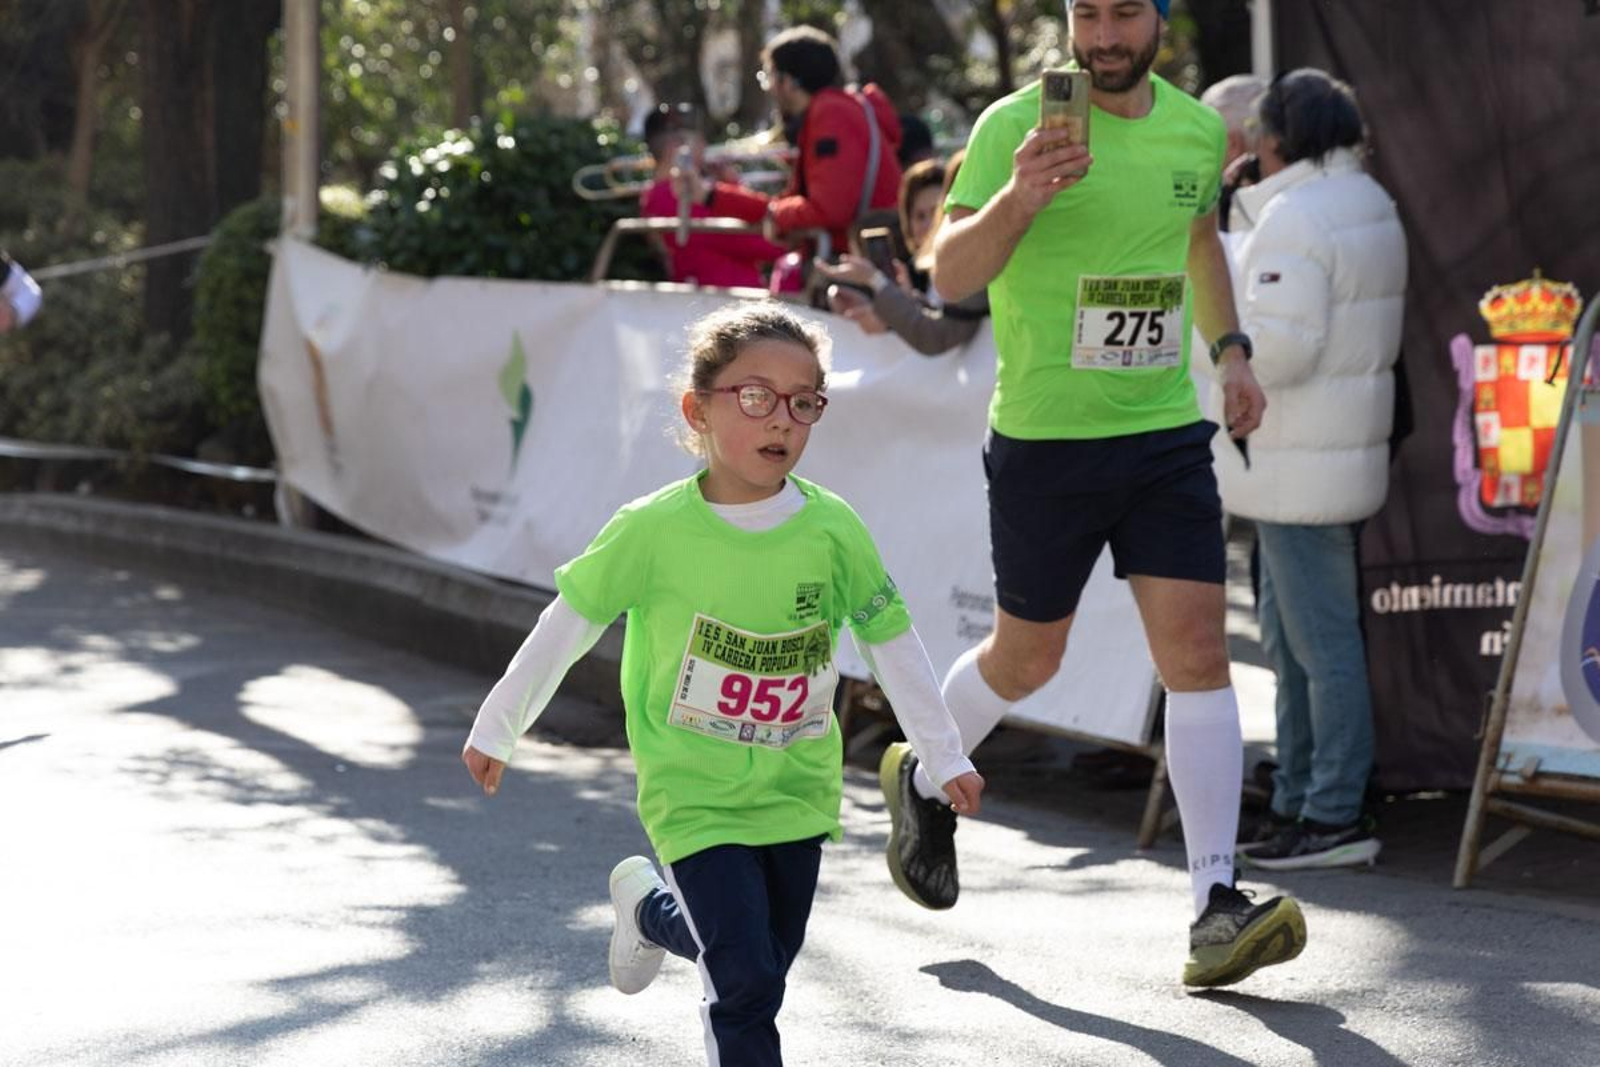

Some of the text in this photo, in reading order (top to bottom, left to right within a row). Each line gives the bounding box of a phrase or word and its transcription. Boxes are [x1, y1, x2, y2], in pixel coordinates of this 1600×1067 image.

[1104, 311, 1165, 346] 275
[701, 639, 798, 673] IV CARRERA POPULAR
[725, 631, 747, 651] SAN
[748, 640, 778, 655] JUAN
[717, 674, 809, 722] 952
